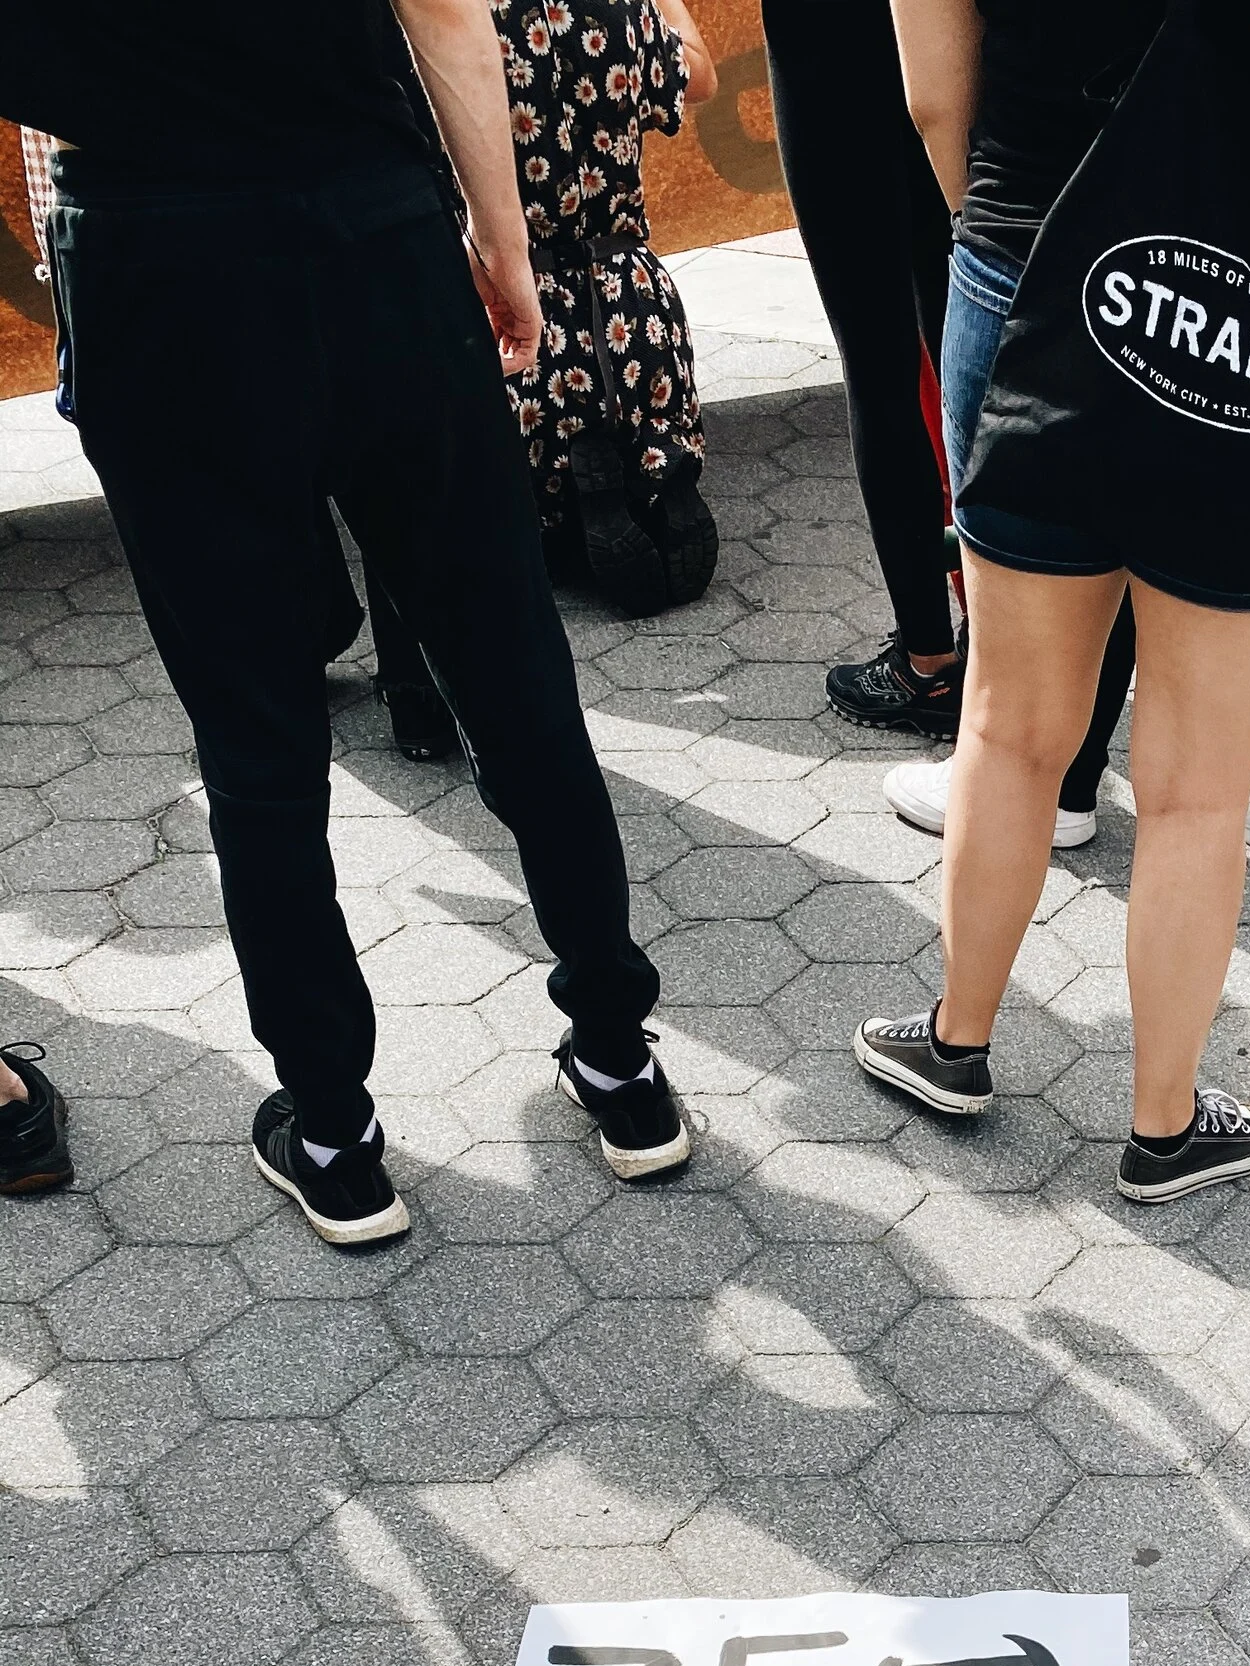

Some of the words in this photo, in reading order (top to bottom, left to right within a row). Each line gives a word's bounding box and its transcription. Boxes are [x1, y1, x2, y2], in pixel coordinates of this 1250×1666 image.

[1148, 250, 1166, 265] 18
[1174, 251, 1219, 277] MILES
[1226, 269, 1245, 287] OF
[1120, 345, 1147, 371] NEW
[1149, 368, 1177, 395] YORK
[1181, 389, 1208, 408] CITY
[1224, 404, 1250, 419] EST.
